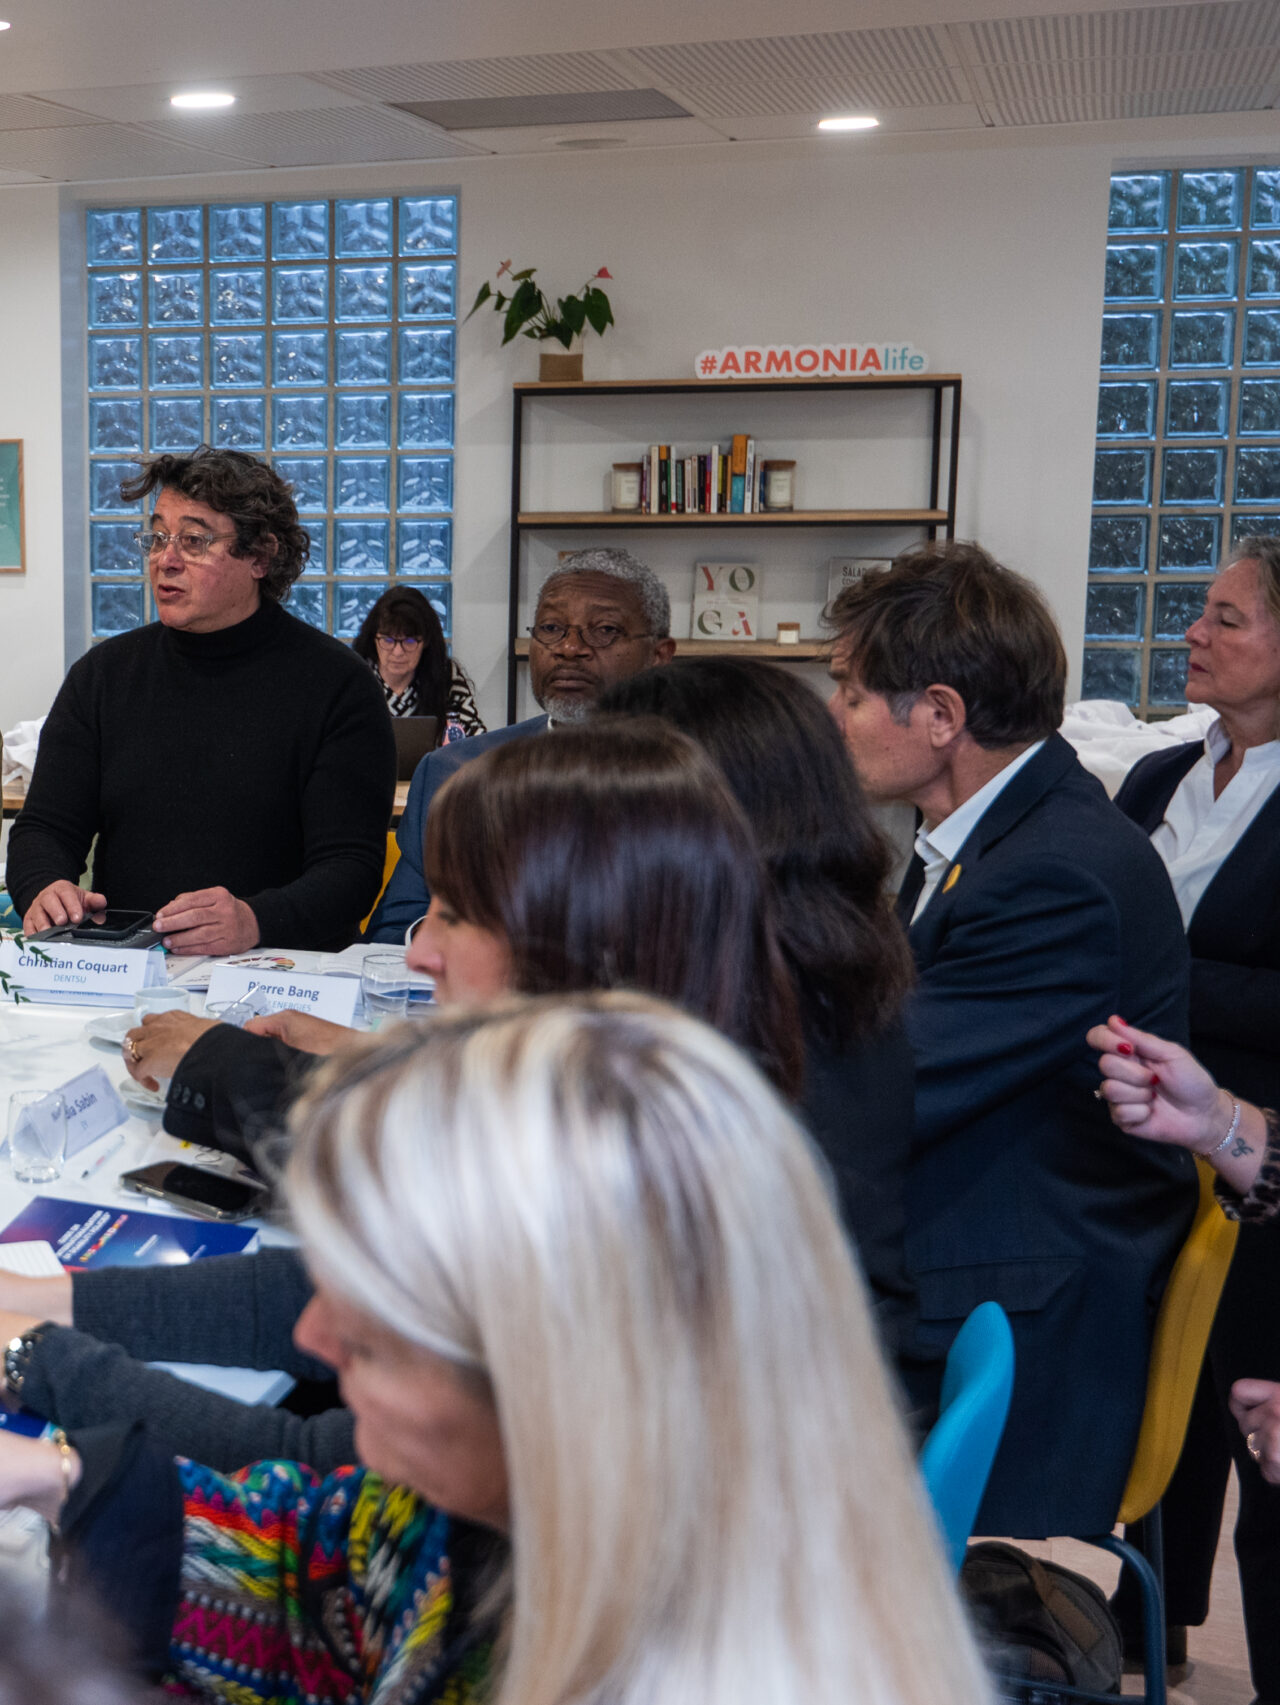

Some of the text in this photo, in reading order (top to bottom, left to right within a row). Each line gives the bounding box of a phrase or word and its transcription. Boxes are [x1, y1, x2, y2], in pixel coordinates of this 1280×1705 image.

[700, 347, 925, 375] #ARMONIAlife
[18, 954, 129, 974] Christian Coquart
[53, 973, 87, 984] DENTSU
[287, 985, 321, 1002] Bang
